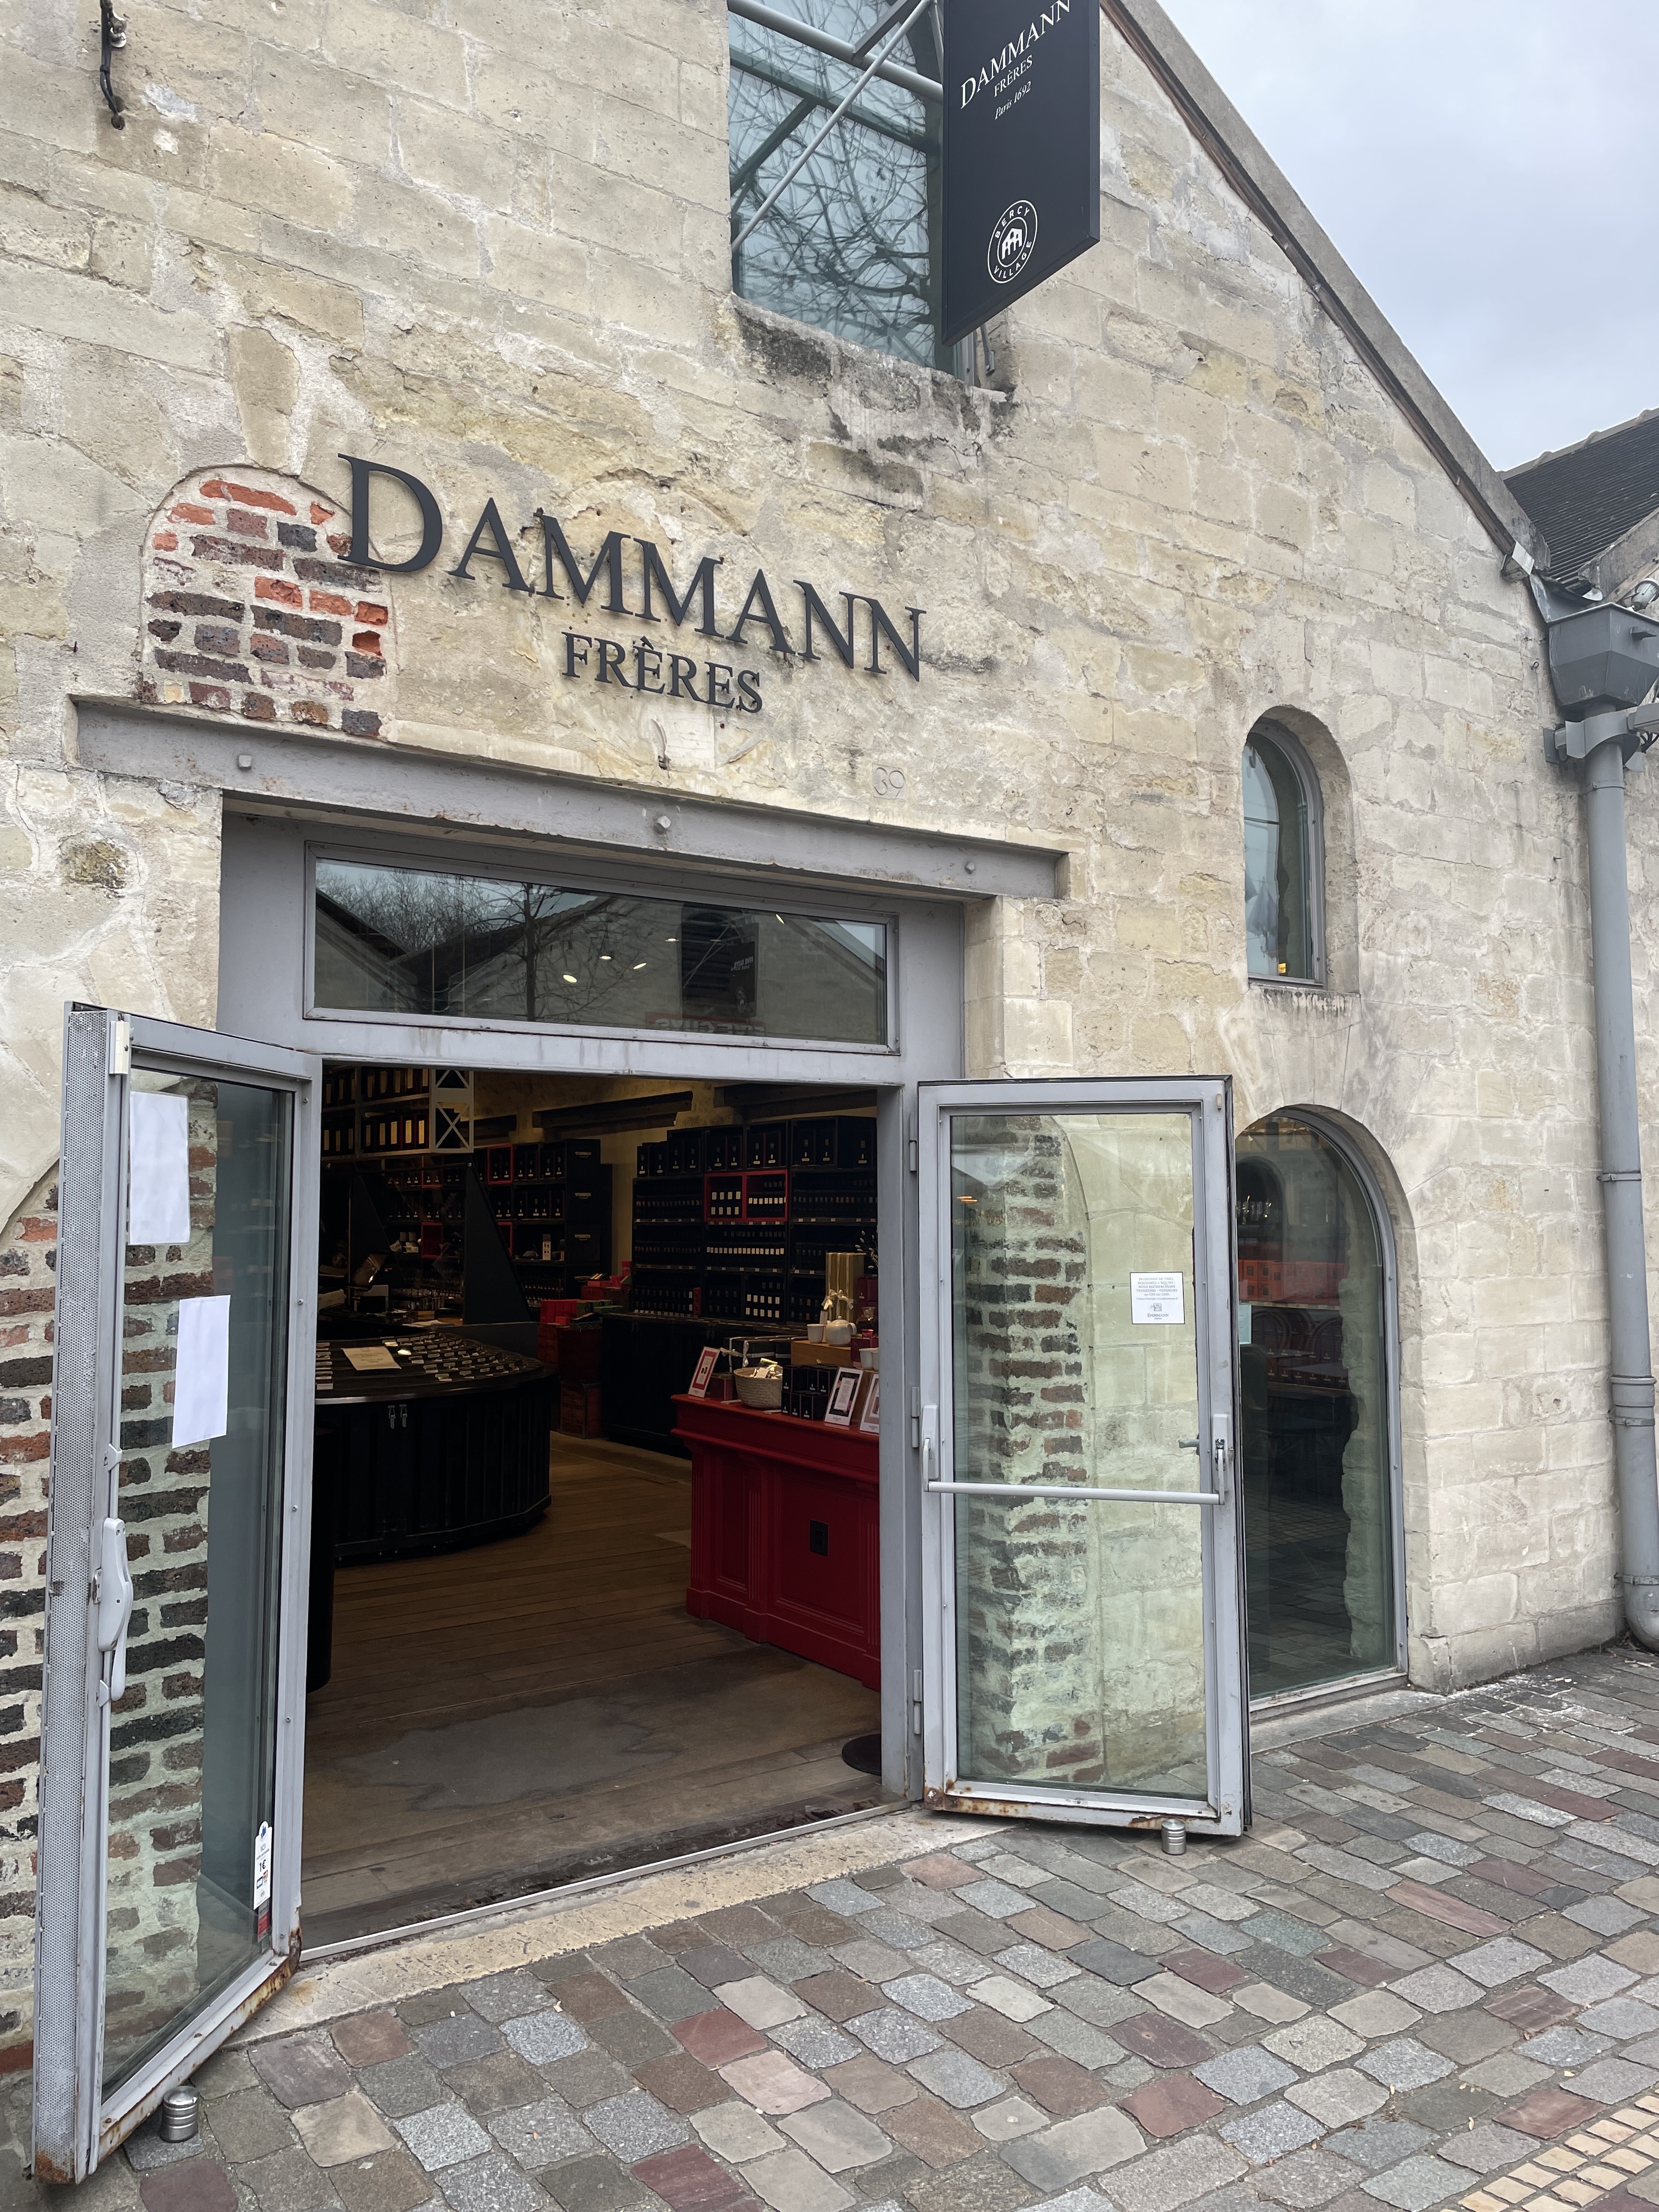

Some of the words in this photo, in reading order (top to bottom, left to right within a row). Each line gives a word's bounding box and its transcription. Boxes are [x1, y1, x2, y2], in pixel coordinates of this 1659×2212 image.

[961, 0, 1069, 109] DAMMANN
[994, 54, 1032, 98] FRÈRES
[995, 98, 1013, 120] Paris
[1014, 81, 1031, 103] 1692
[995, 205, 1030, 239] BERCY
[994, 241, 1032, 279] VILLAGE
[337, 453, 927, 682] DAMMANN
[561, 631, 763, 714] FRÈRES
[874, 767, 906, 798] 39
